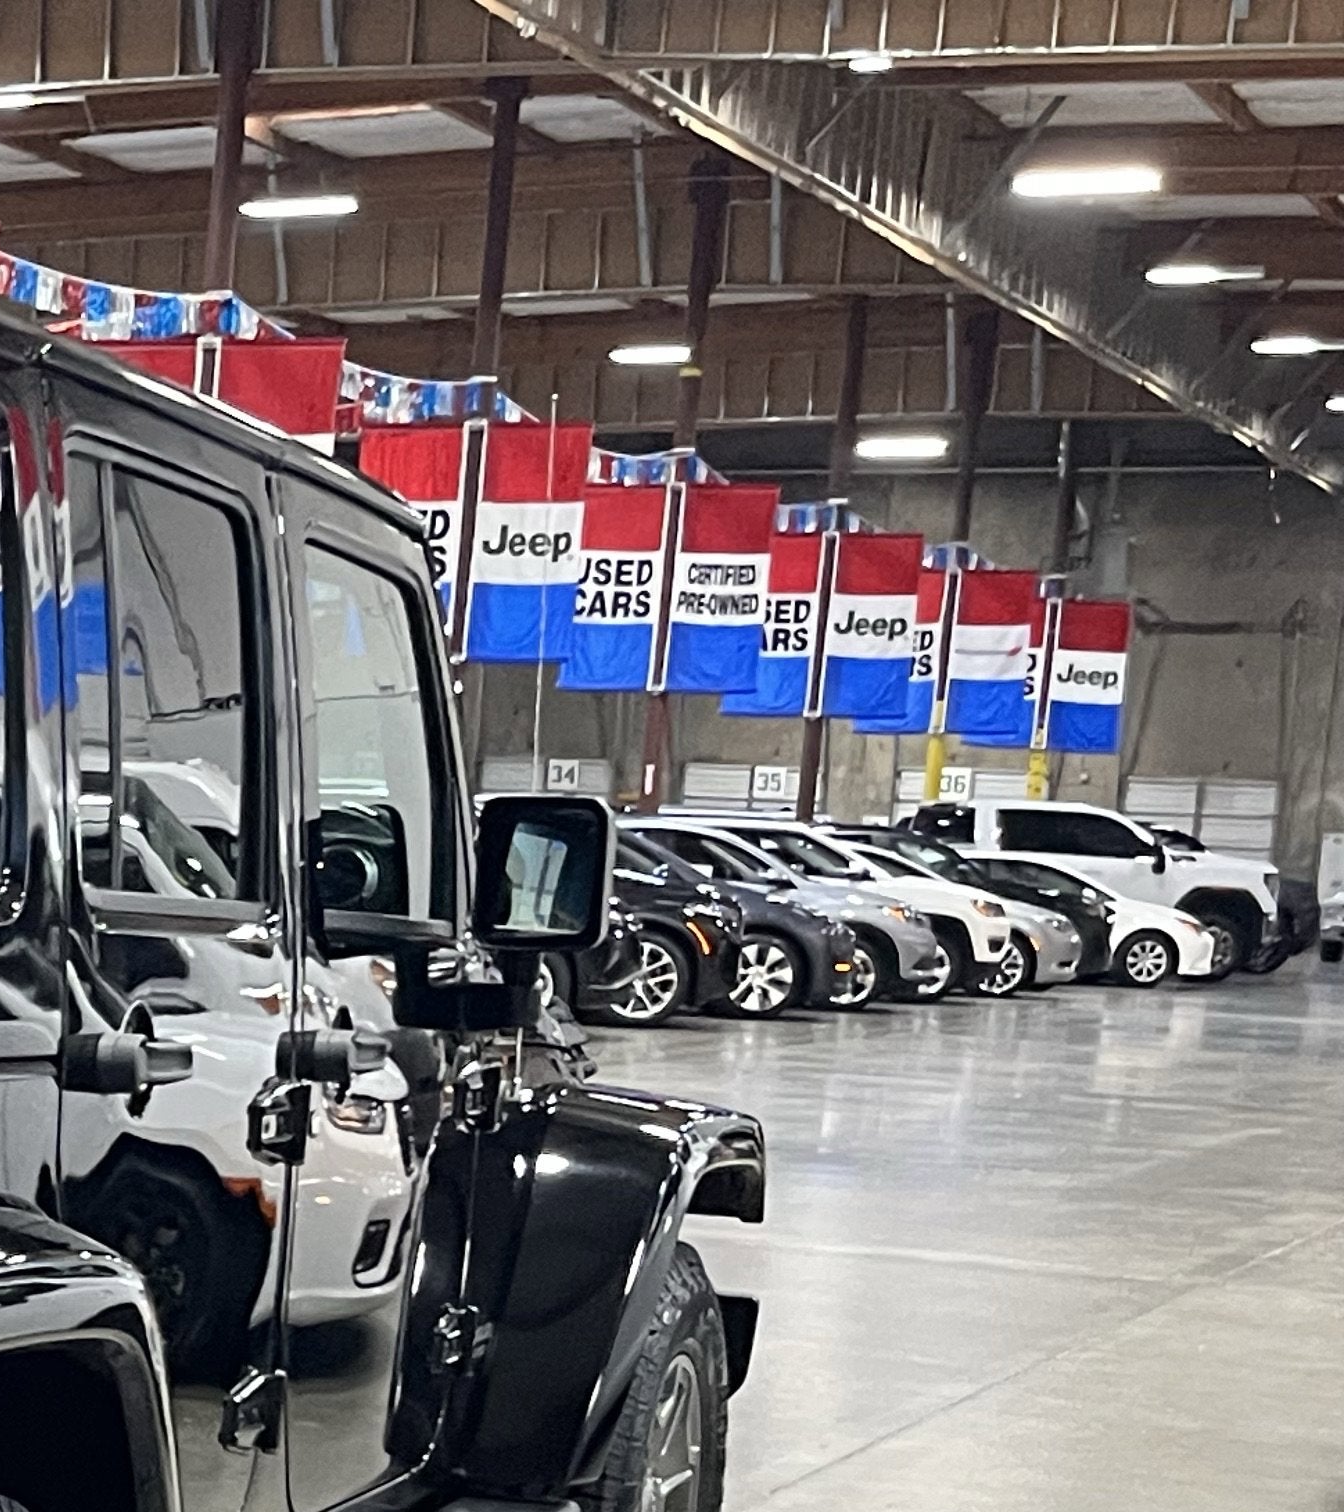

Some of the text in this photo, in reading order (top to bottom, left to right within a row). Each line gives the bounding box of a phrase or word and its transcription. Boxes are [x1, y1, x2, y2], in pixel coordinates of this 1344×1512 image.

[482, 524, 573, 563] Jeep
[687, 562, 757, 586] CERTIFIED
[676, 591, 759, 615] PRE-OWNED
[833, 610, 908, 641] Jeep
[1056, 663, 1119, 690] Jeep
[551, 765, 576, 785] 34
[756, 772, 782, 793] 35
[940, 774, 966, 794] 36
